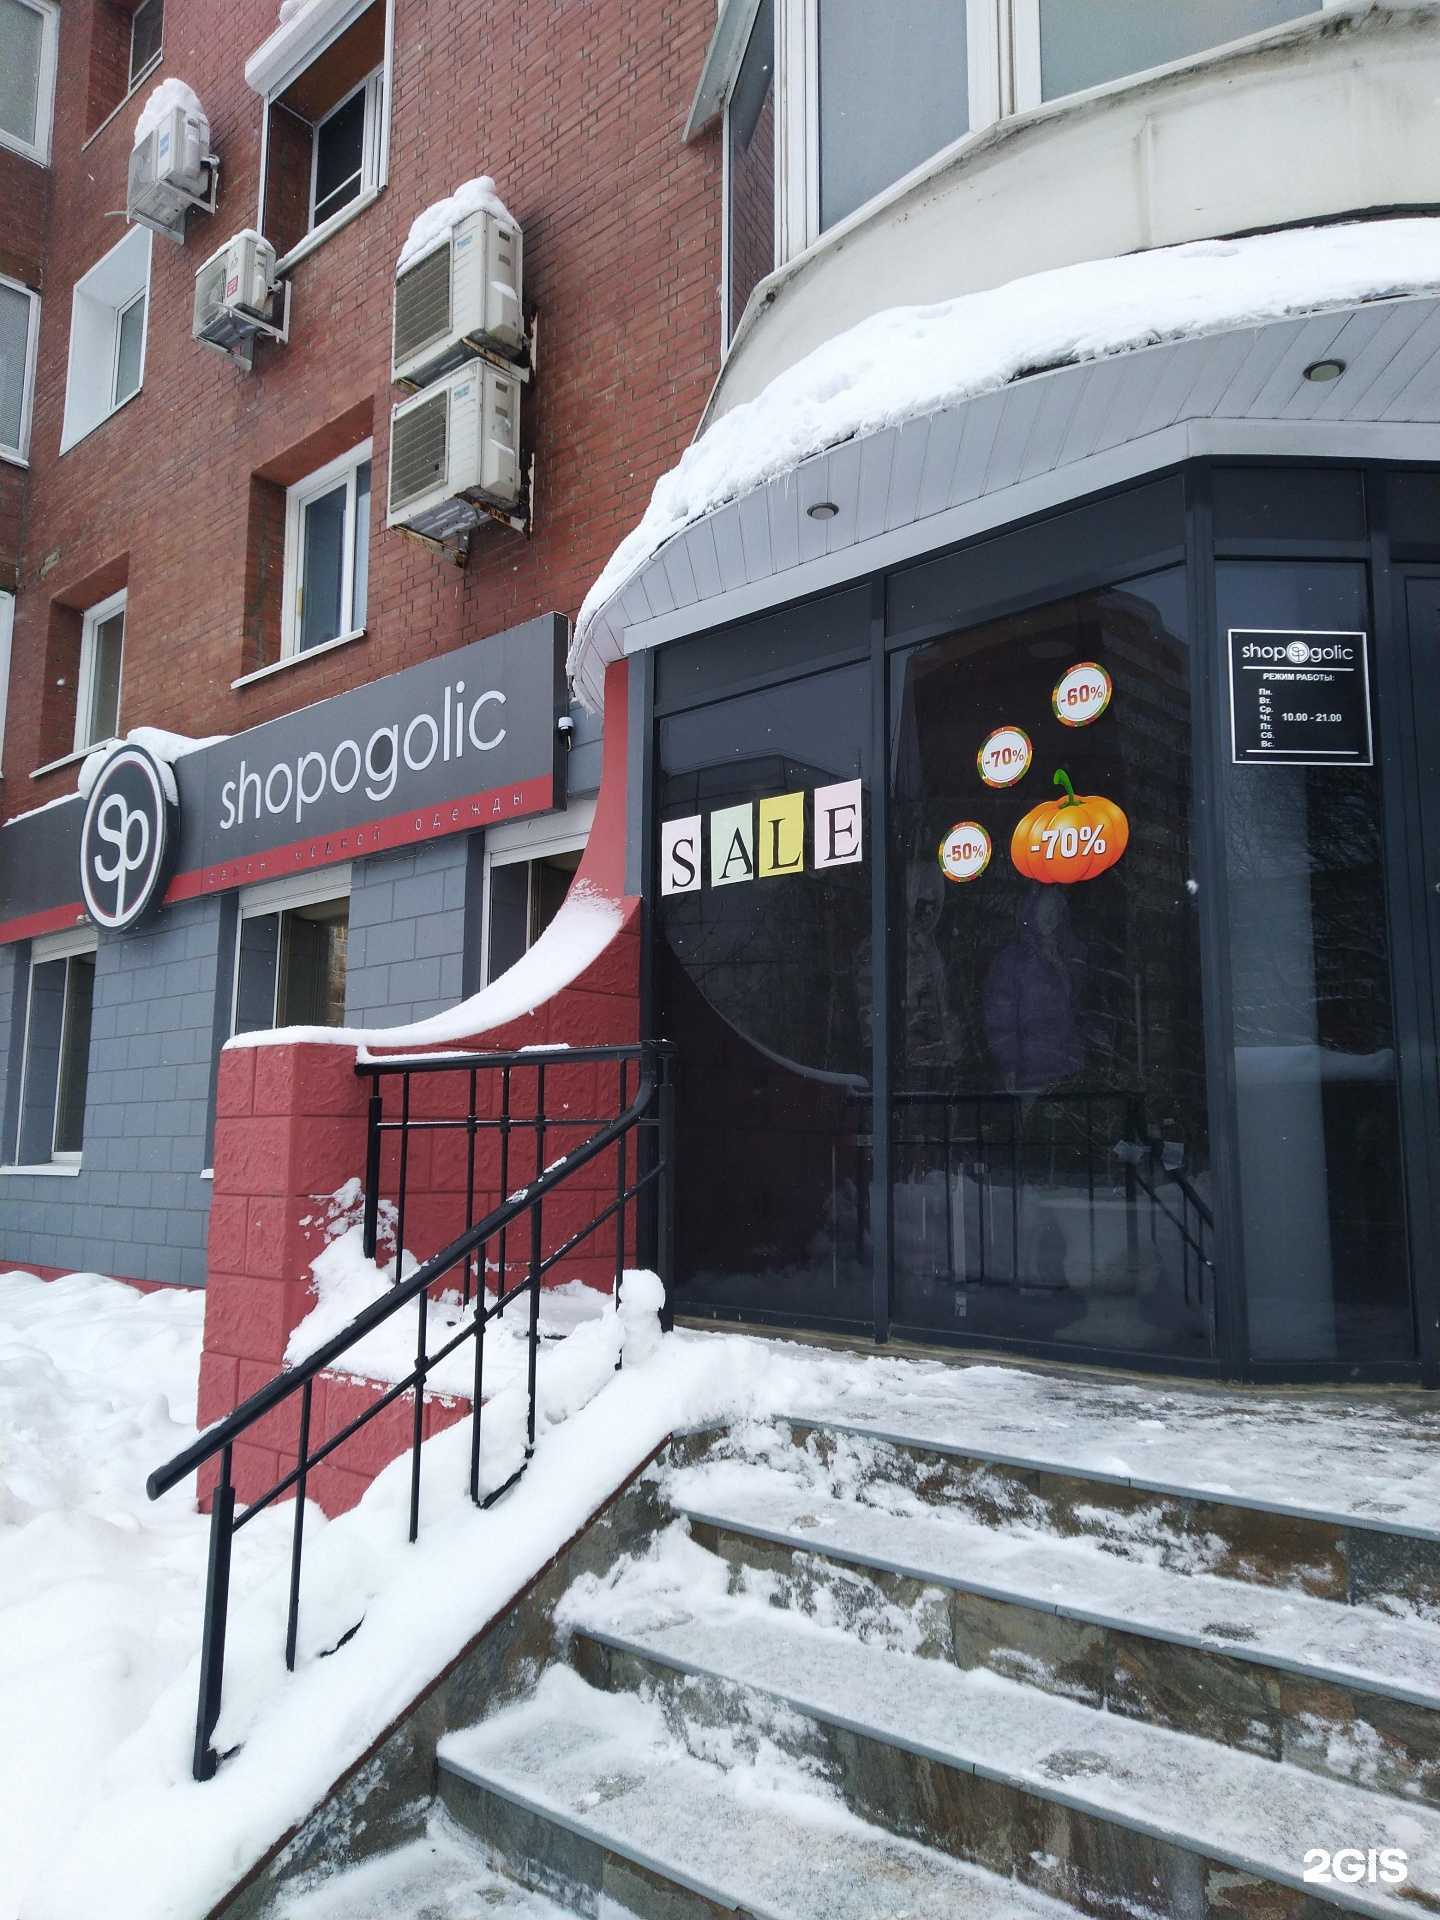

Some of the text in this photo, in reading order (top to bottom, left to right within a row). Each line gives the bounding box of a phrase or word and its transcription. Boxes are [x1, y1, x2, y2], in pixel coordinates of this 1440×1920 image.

[1262, 672, 1295, 681] РЕЖИМ
[1060, 684, 1103, 706] -60%
[1282, 712, 1308, 721] 10.00
[1315, 713, 1342, 722] 21.00
[219, 680, 507, 830] shopogolic
[985, 747, 1024, 768] -70%
[671, 803, 860, 889] SALE
[946, 842, 984, 862] -50%
[1030, 824, 1107, 860] -70%
